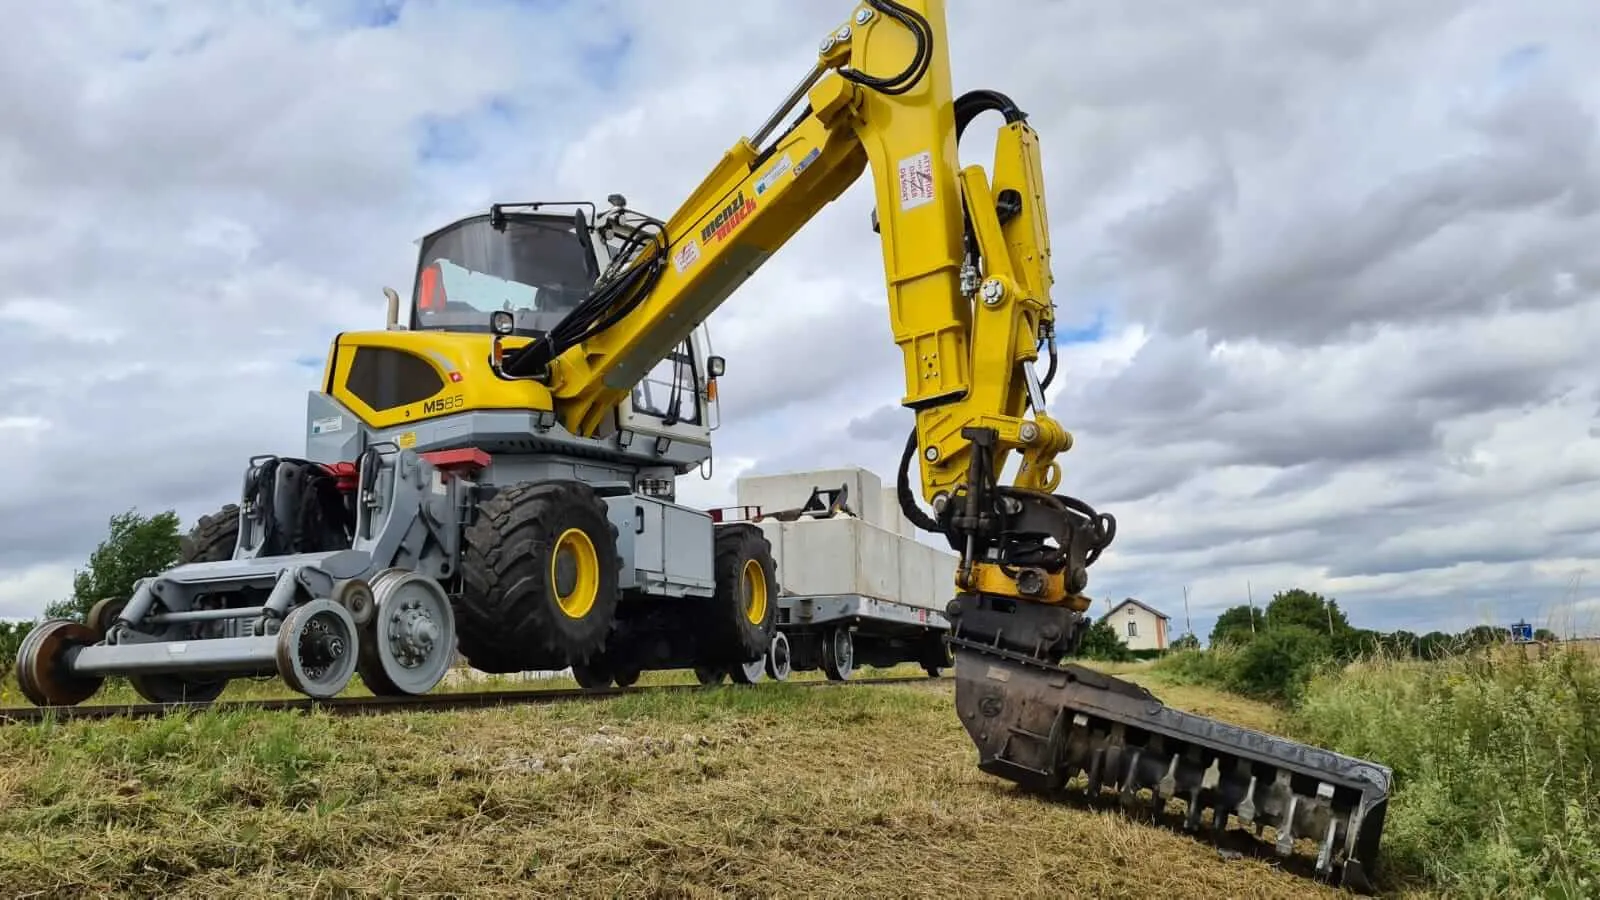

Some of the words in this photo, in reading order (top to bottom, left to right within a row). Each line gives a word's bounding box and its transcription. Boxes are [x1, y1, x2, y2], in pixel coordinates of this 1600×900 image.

[700, 190, 744, 243] menzi
[717, 197, 757, 242] muck
[423, 394, 464, 415] M585
